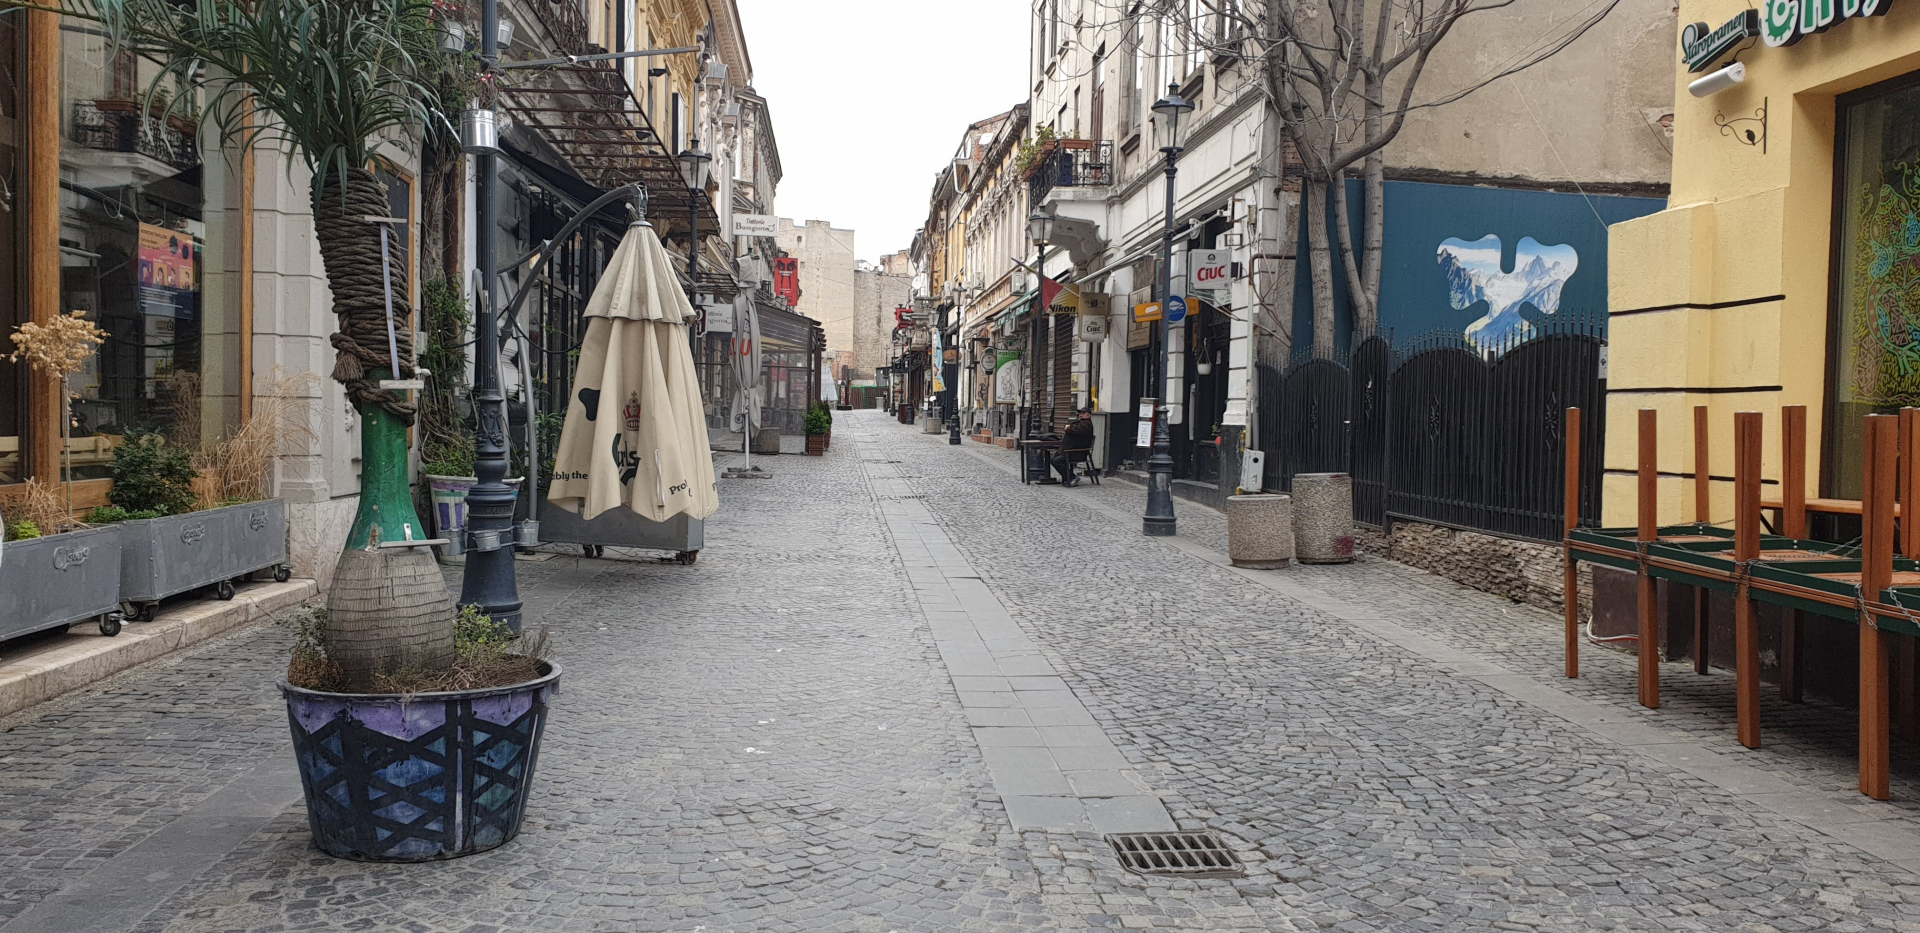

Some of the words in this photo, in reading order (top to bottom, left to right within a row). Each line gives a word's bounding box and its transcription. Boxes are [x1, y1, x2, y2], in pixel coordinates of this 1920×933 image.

[1681, 10, 1748, 64] Staropramen
[1049, 305, 1077, 313] Nikon
[572, 471, 588, 480] the
